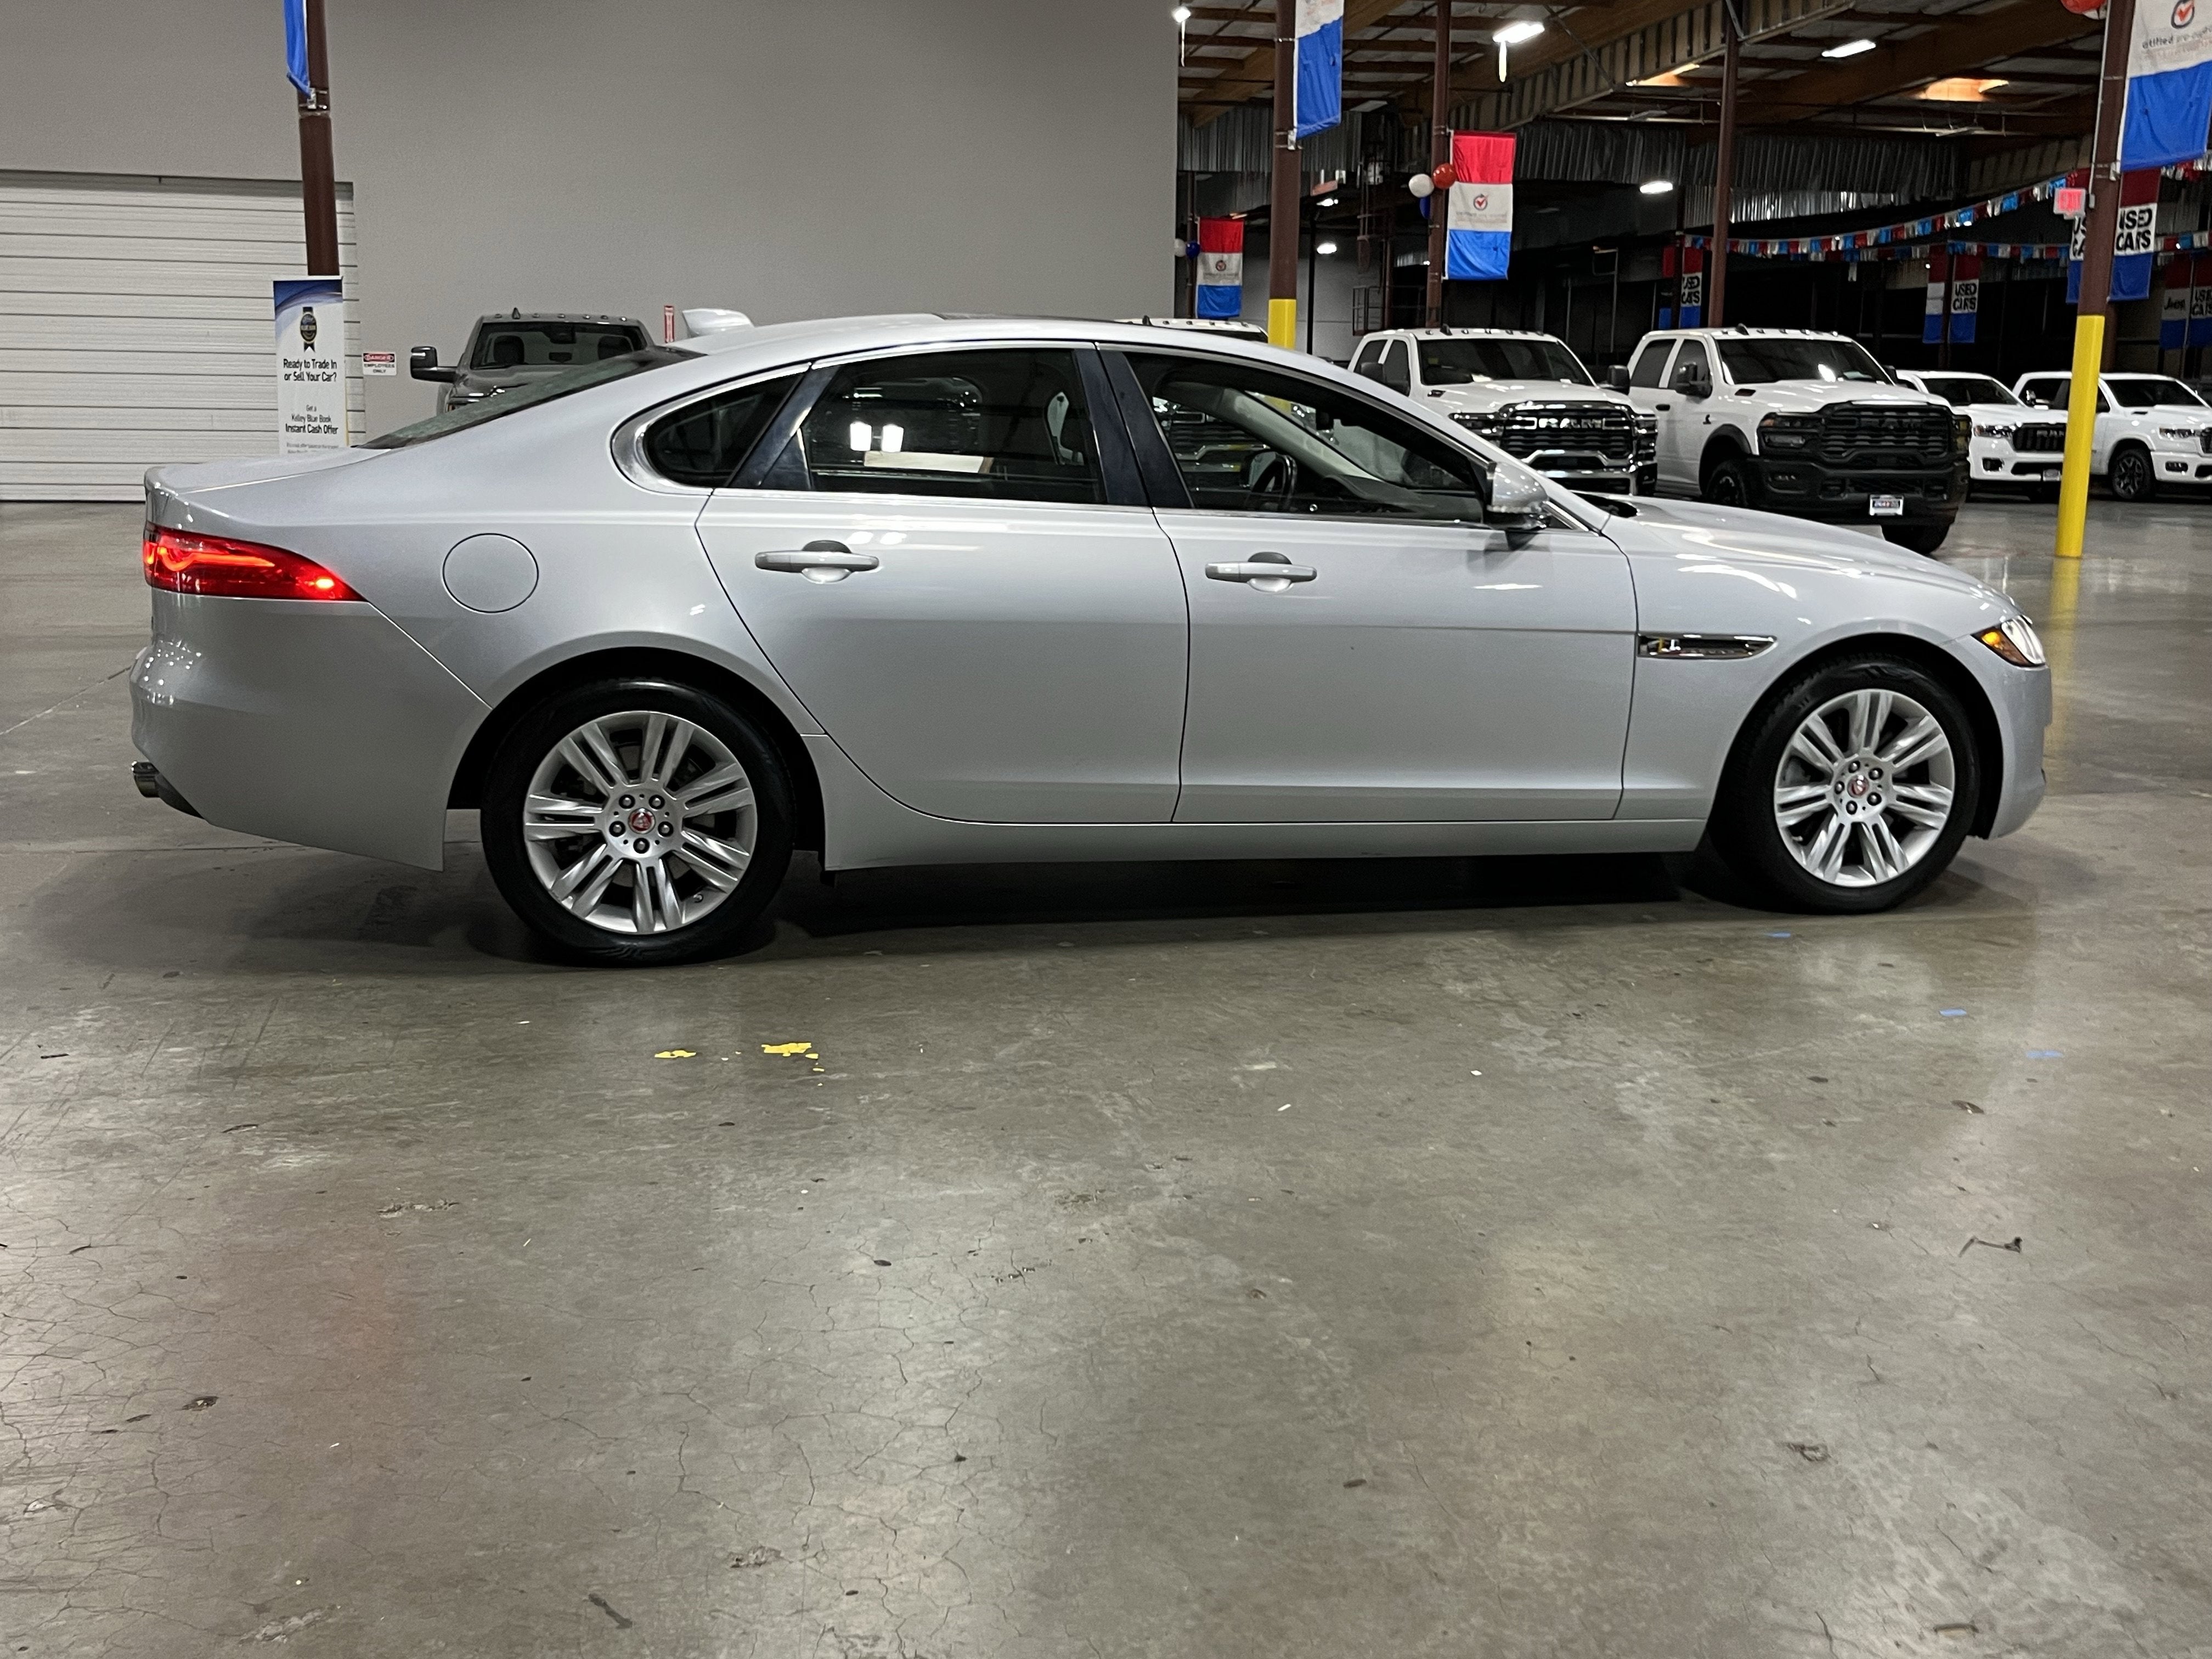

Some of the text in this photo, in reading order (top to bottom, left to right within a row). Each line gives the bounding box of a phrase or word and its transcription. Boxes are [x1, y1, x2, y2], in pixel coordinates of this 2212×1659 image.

[1955, 284, 1977, 296] USED
[1953, 297, 1977, 311] CARS
[283, 358, 337, 371] Ready to Trade In
[293, 371, 304, 381] Sell
[306, 372, 321, 381] Your
[321, 371, 337, 382] Car?
[307, 414, 318, 422] Blue
[319, 414, 331, 422] Book
[1538, 417, 1602, 428] RAM
[285, 423, 338, 435] Instant Cash Offer
